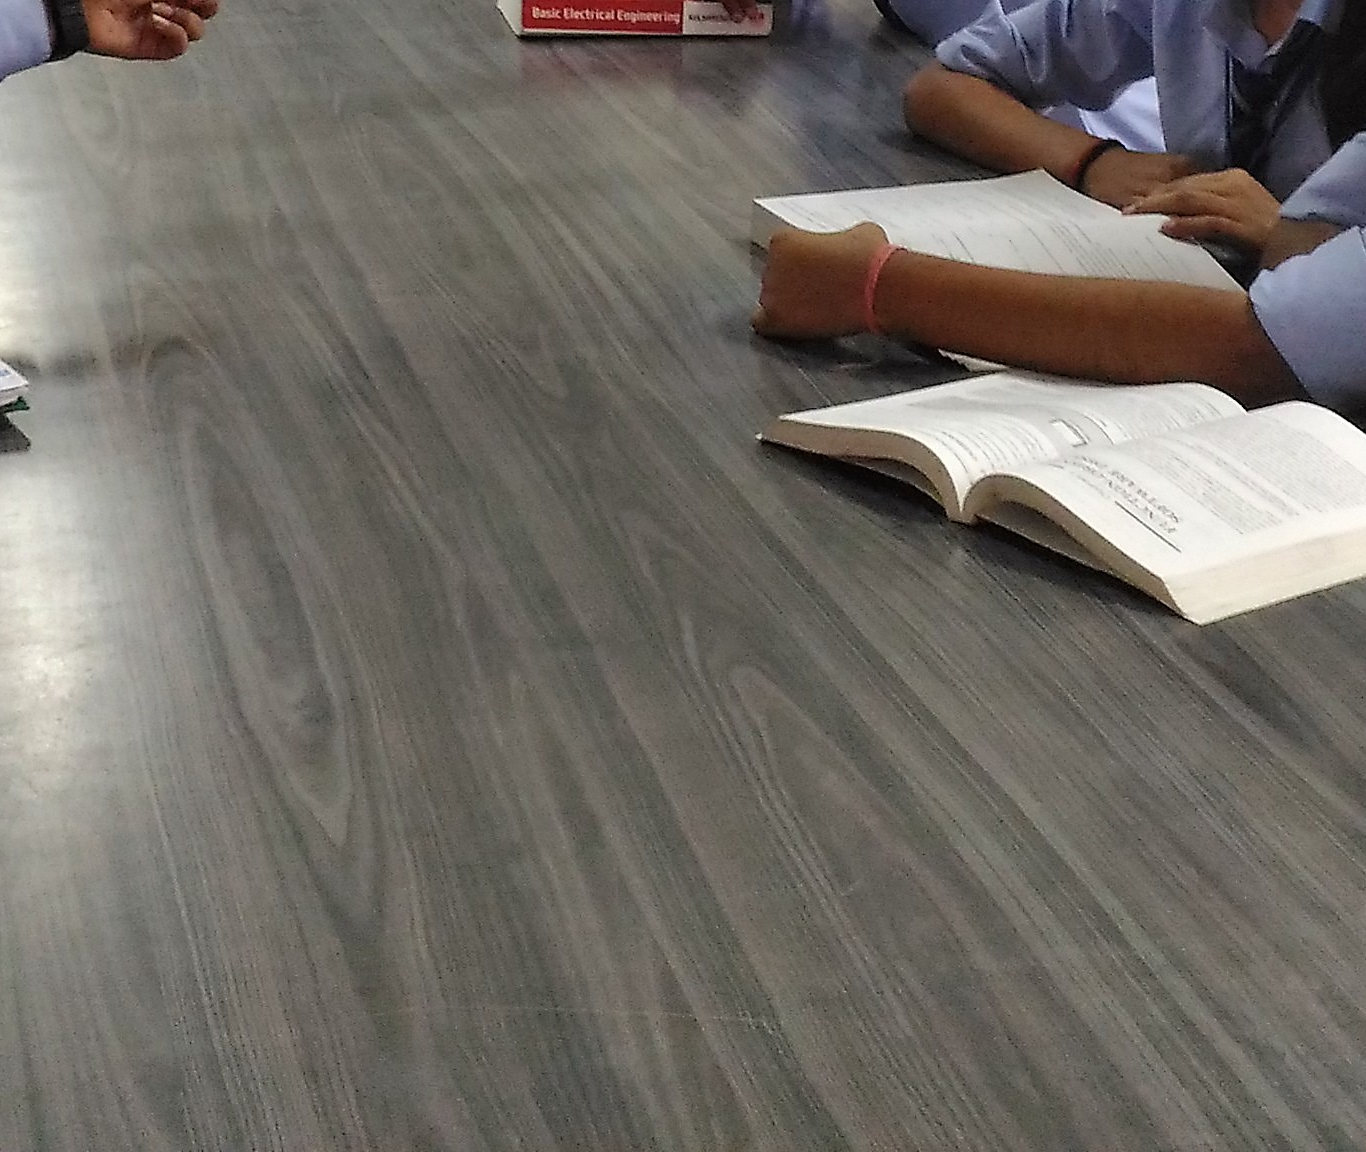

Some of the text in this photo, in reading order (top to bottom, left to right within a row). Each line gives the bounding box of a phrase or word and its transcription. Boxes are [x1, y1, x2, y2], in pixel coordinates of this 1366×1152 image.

[532, 6, 562, 19] Basic
[563, 7, 615, 21] Electrical
[616, 9, 680, 25] Engineering
